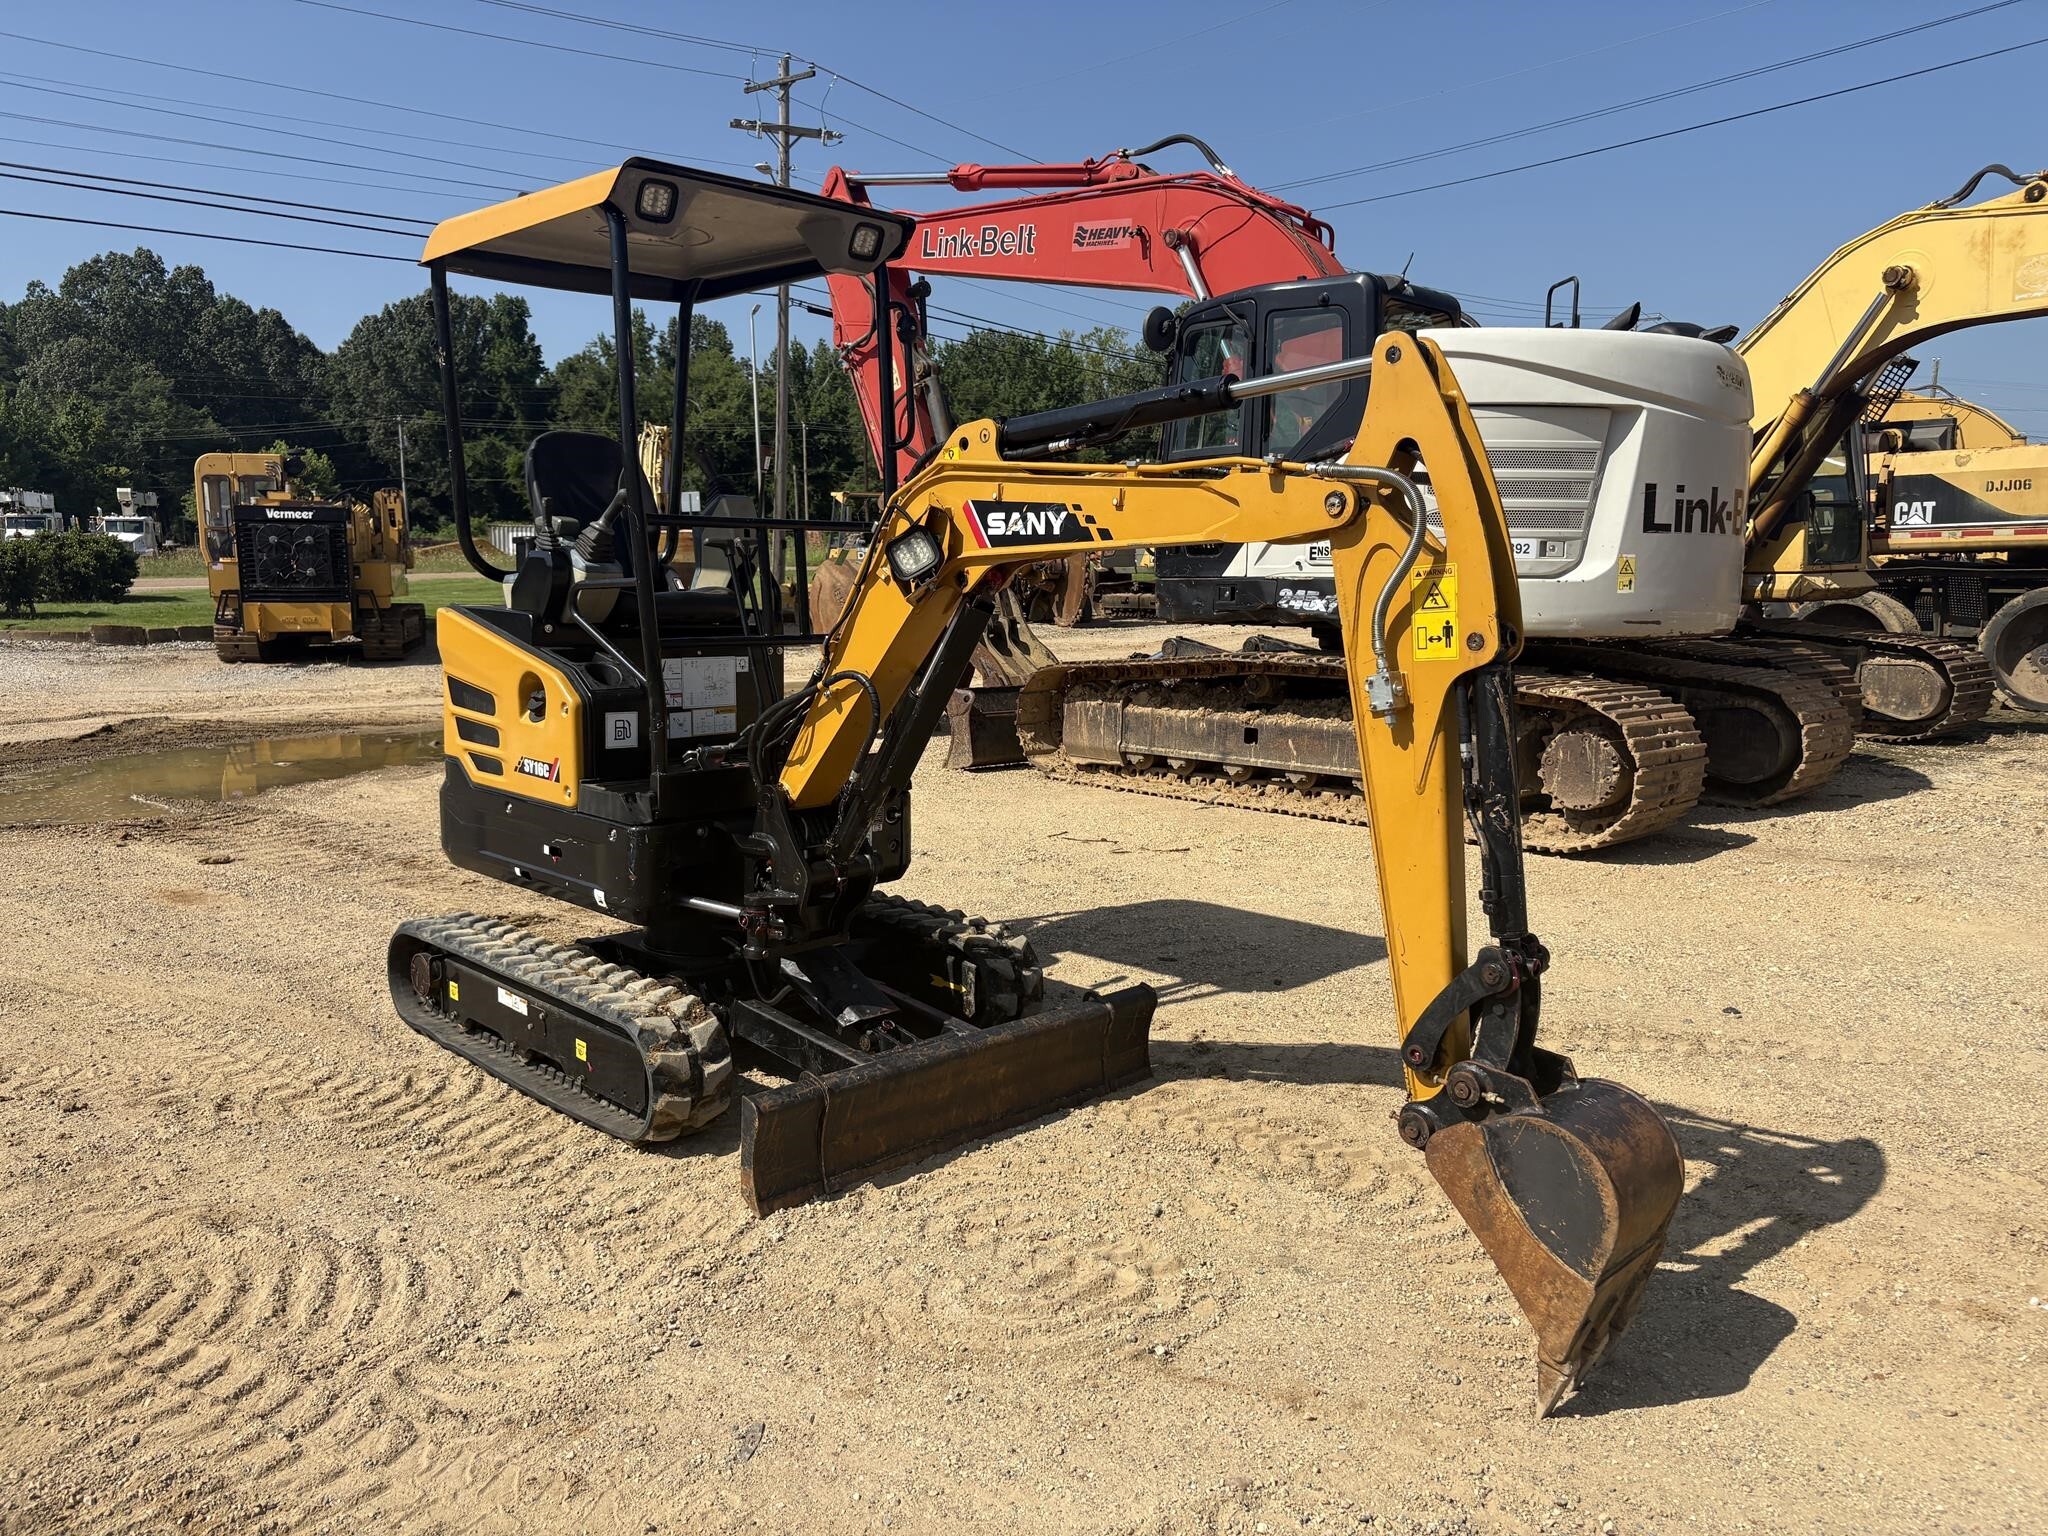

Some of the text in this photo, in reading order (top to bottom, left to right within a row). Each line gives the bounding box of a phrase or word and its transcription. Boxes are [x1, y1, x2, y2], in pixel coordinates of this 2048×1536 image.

[921, 224, 1036, 259] Link-Belt
[1088, 226, 1130, 241] HEAVY
[1085, 240, 1114, 248] MACHINES
[265, 508, 314, 519] Vermeer
[1894, 501, 1937, 525] CAT
[987, 511, 1068, 536] SANY
[1422, 568, 1453, 577] WARNING
[523, 758, 550, 778] SY16C
